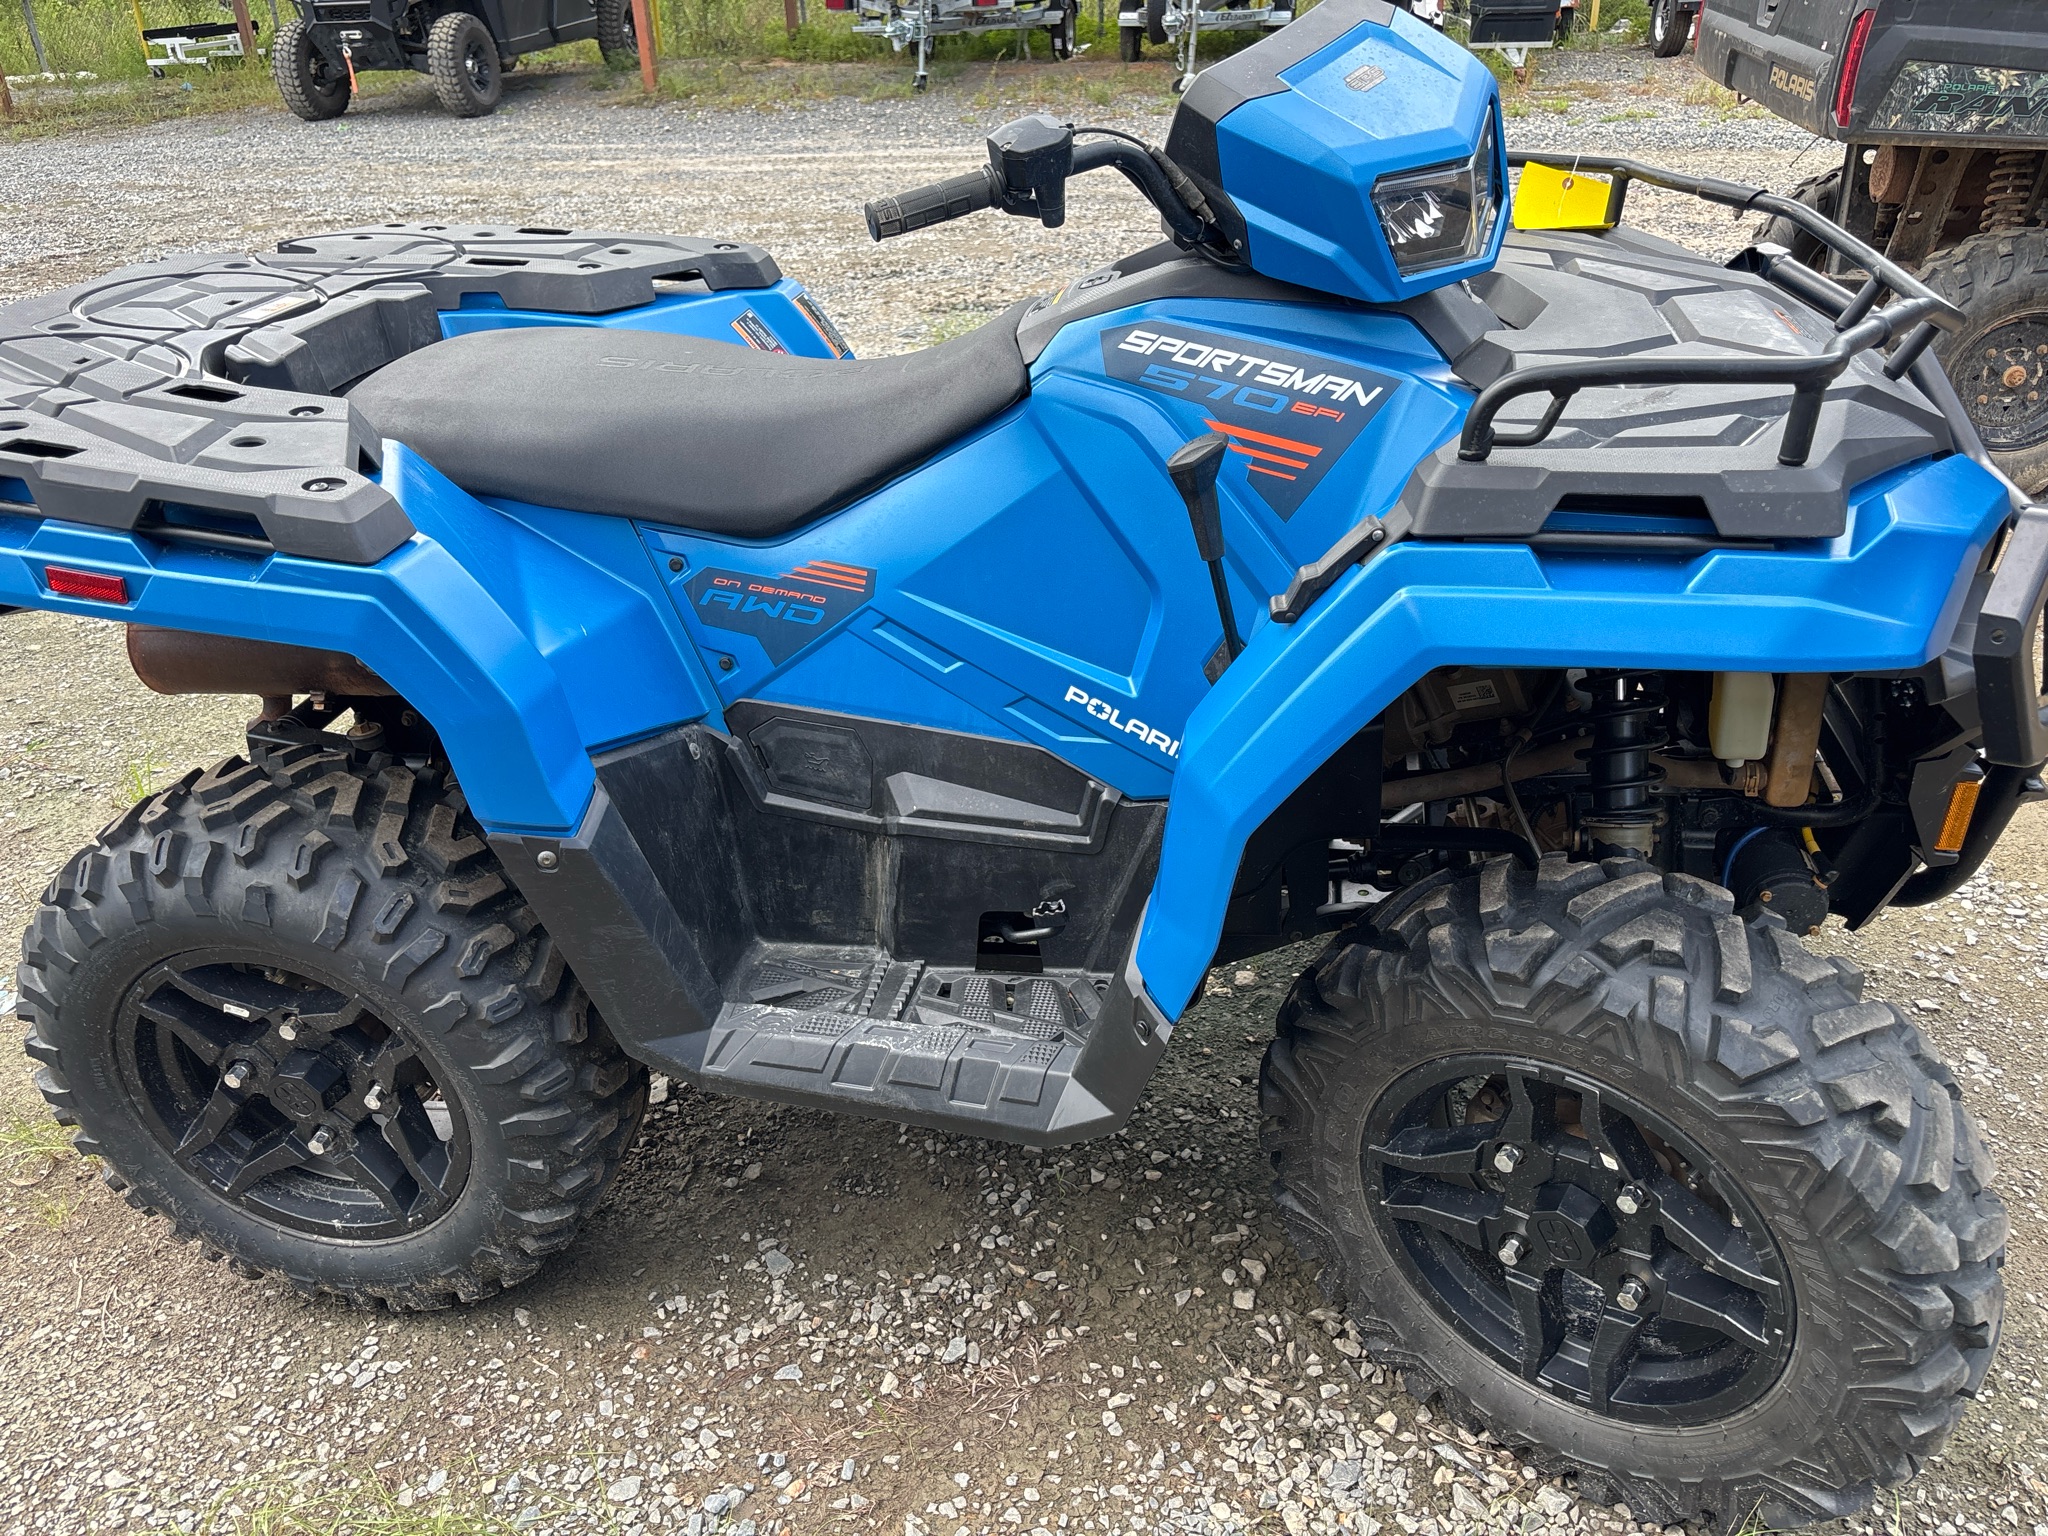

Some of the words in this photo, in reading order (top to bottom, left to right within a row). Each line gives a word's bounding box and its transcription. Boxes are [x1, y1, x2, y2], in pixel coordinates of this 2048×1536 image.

[1769, 65, 1814, 102] POLARIS
[1944, 83, 1996, 93] POLARIS
[1118, 330, 1383, 407] SPORTSMAN
[1139, 363, 1290, 414] 570
[1291, 401, 1346, 422] EFI
[699, 588, 825, 625] AWD
[713, 577, 742, 588] ON
[748, 583, 827, 604] DEMAND
[1064, 685, 1179, 759] POLARI
